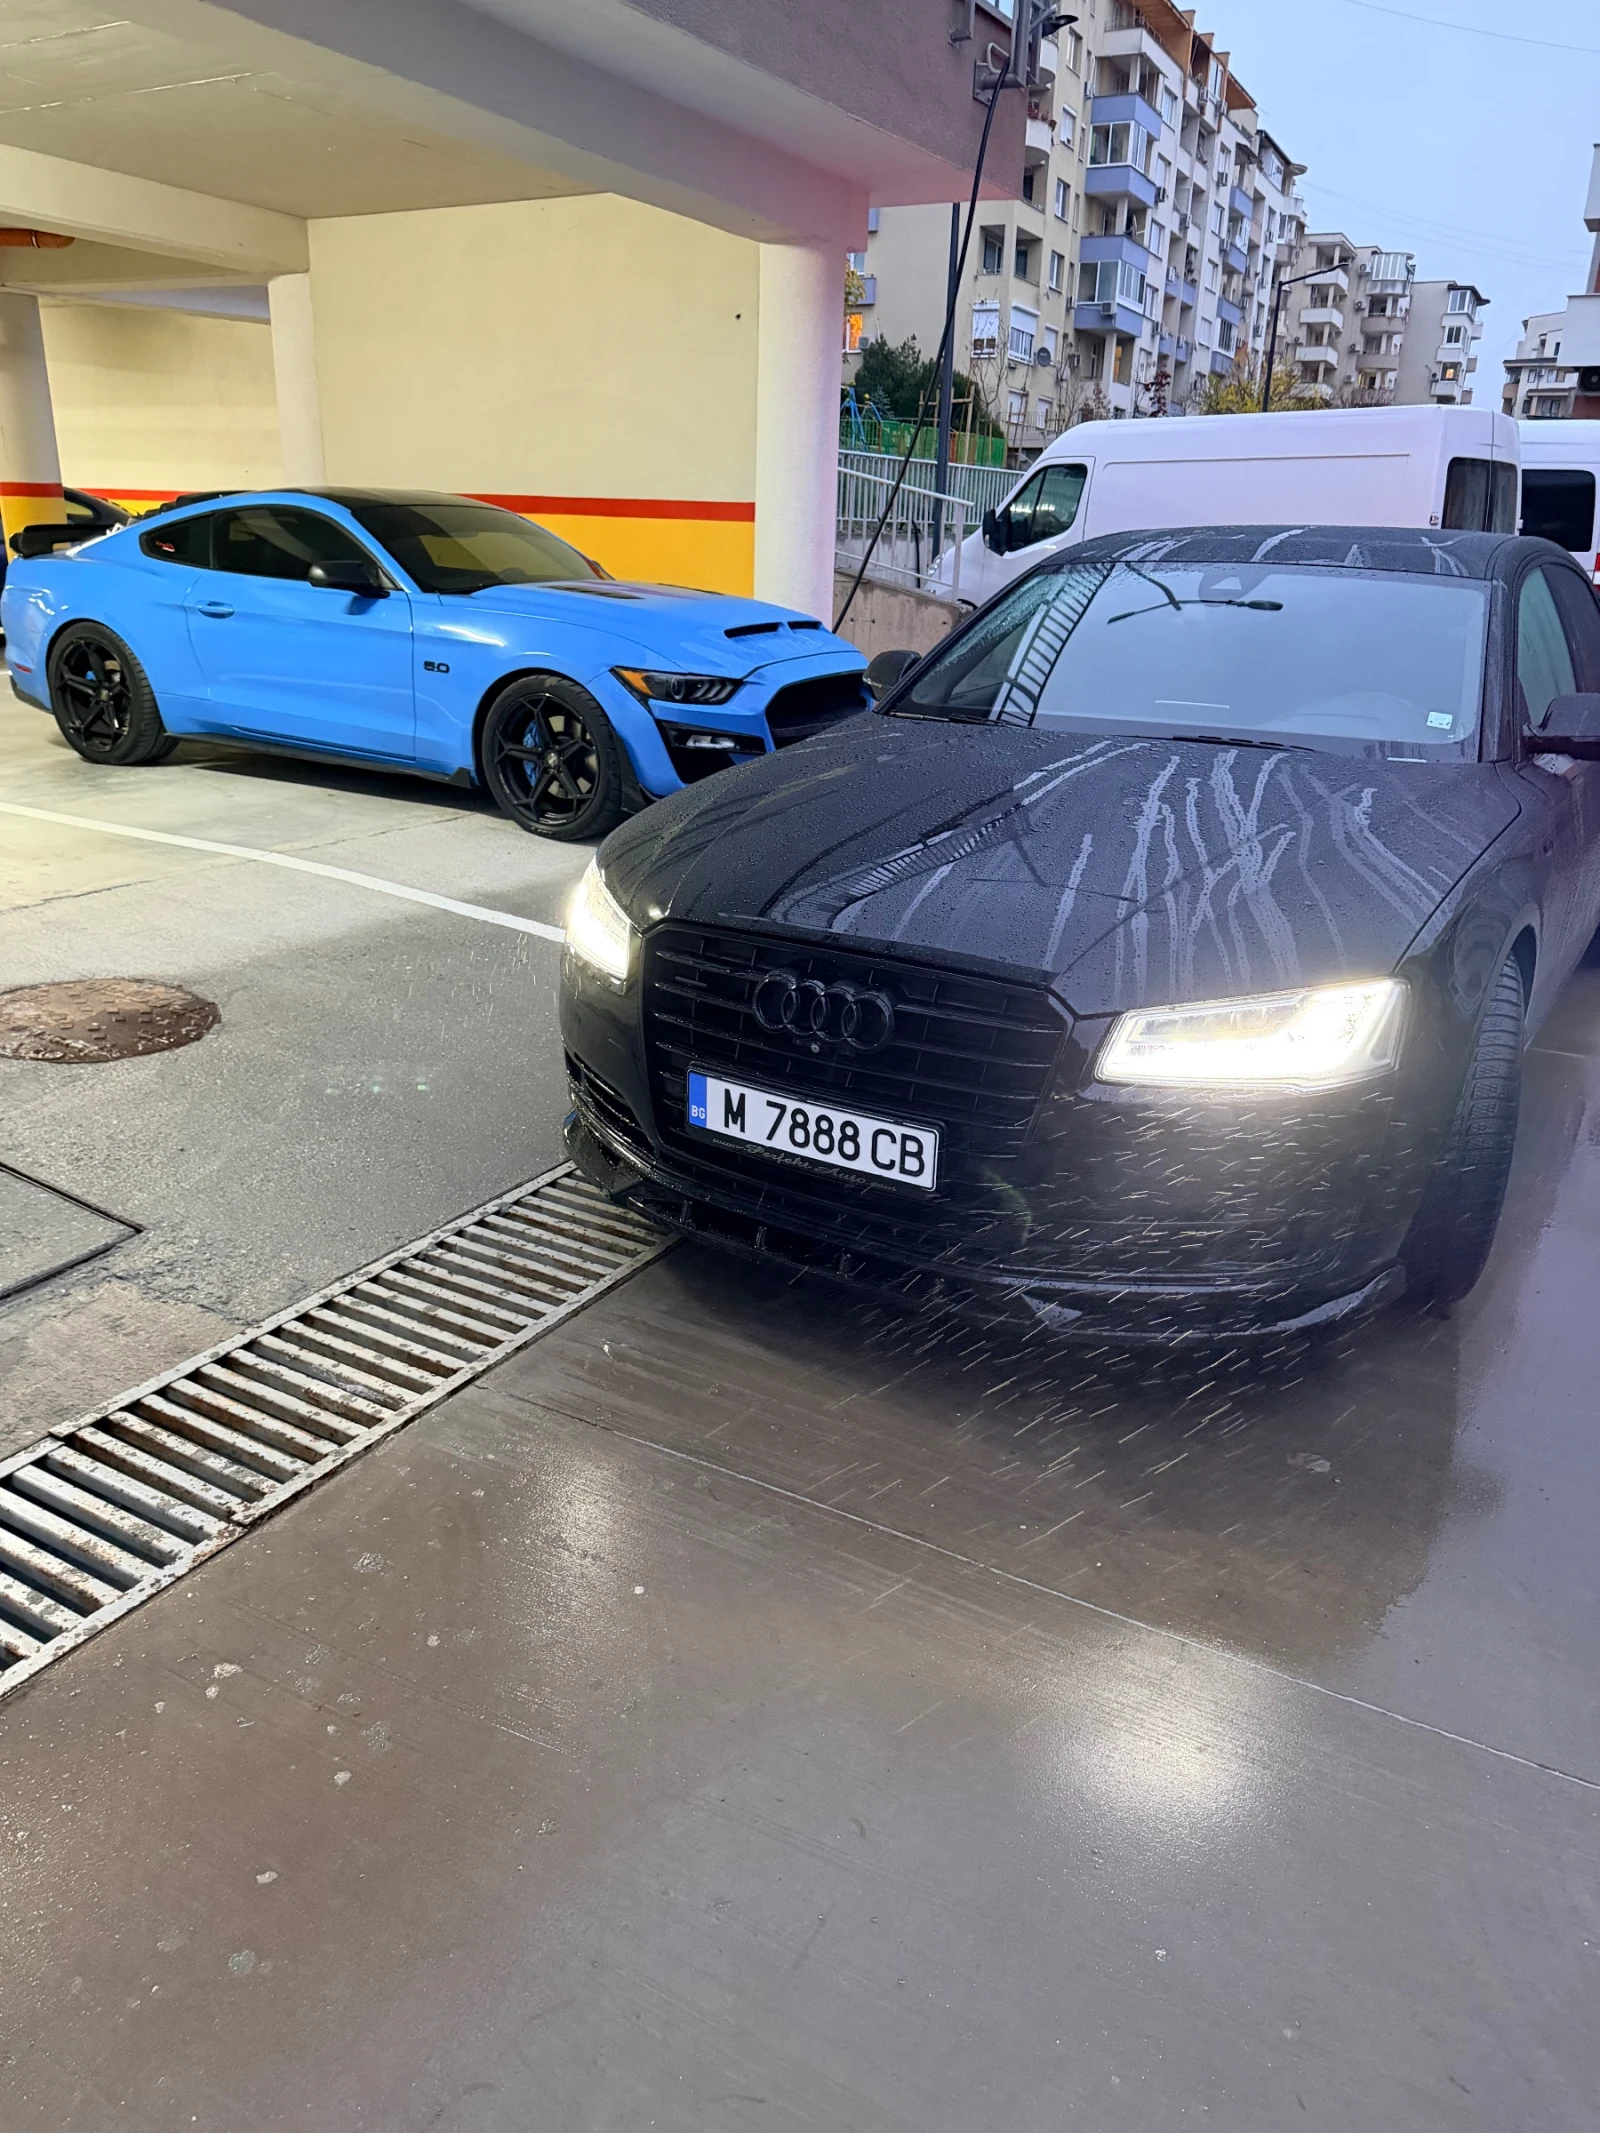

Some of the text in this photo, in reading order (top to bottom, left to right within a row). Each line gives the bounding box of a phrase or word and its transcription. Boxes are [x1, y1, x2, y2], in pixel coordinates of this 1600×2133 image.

[423, 660, 450, 674] 5.0
[691, 1104, 706, 1120] BG
[723, 1088, 925, 1177] M 7888 CB
